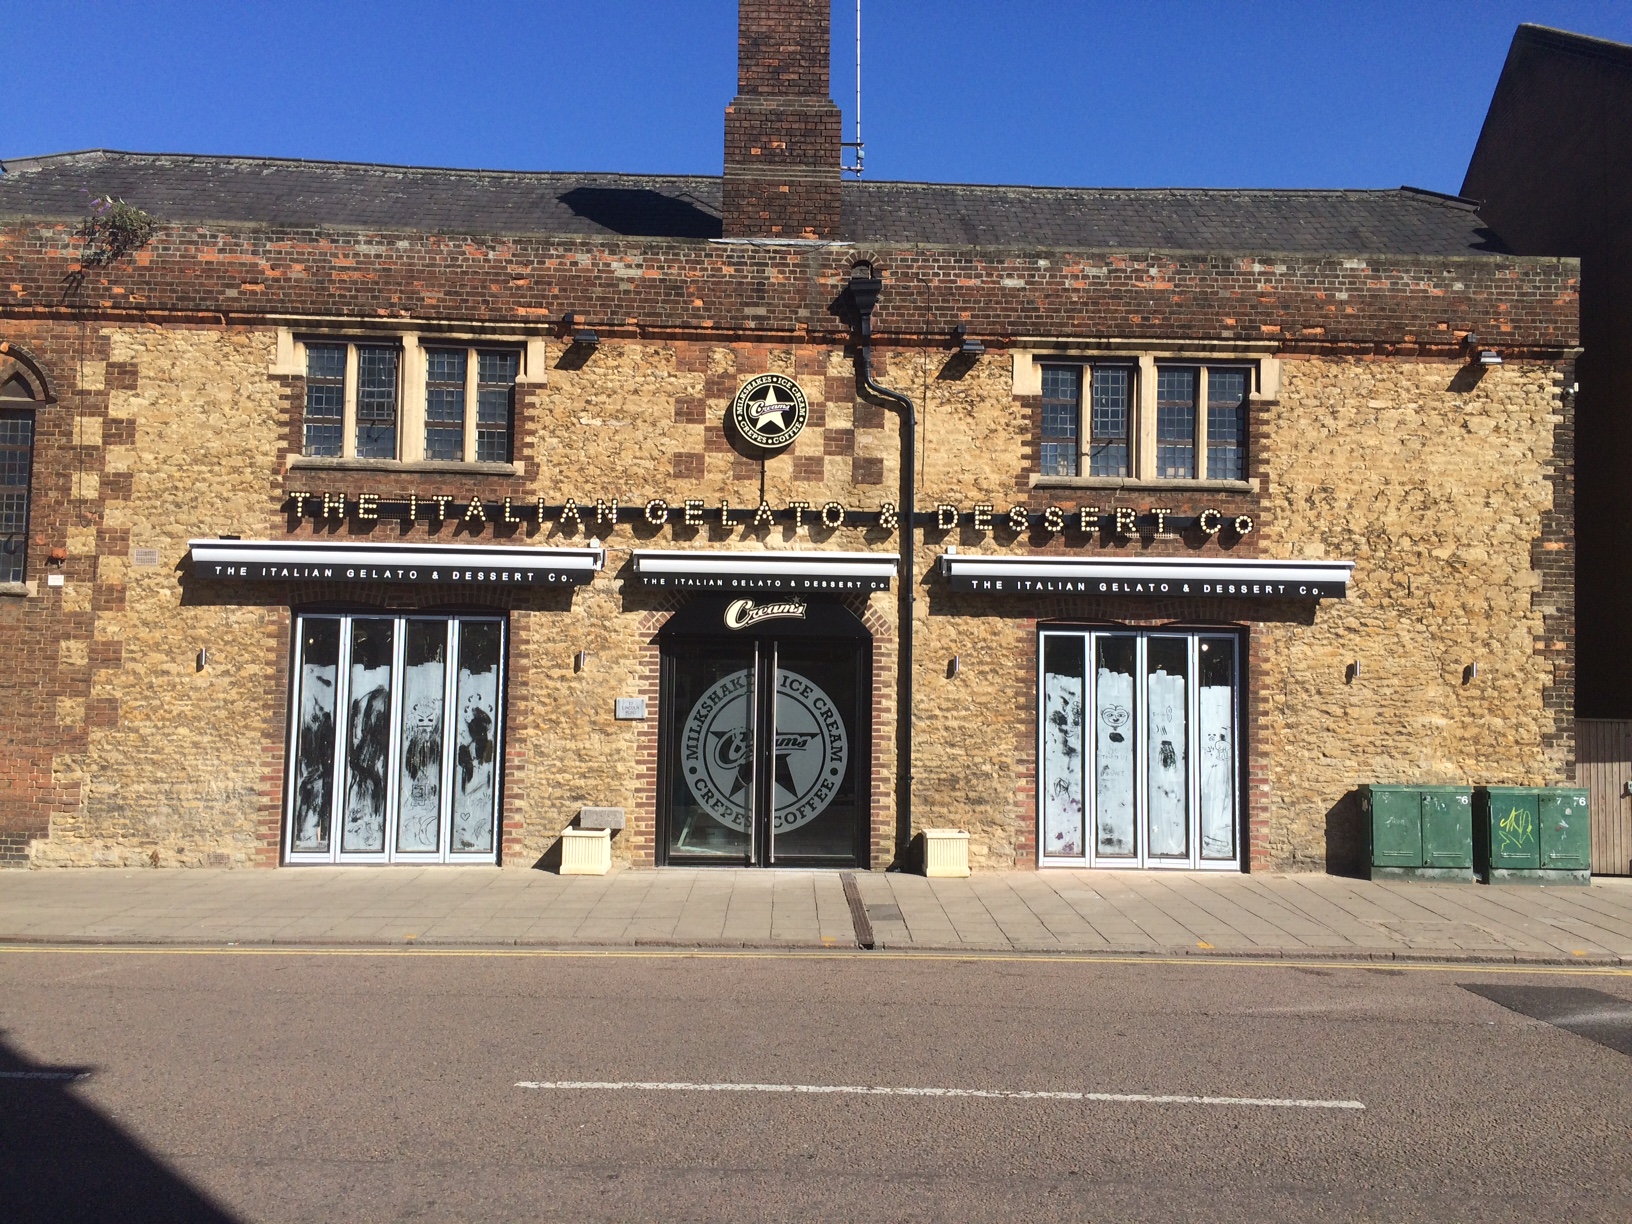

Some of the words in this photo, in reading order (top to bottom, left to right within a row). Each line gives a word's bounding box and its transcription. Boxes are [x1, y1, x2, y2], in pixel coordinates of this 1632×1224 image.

[737, 376, 772, 415] MILKSHAKES
[777, 377, 792, 389] ICE
[791, 387, 806, 416] CREAM
[740, 421, 767, 443] CREPES
[773, 421, 802, 444] COFFEE
[289, 491, 379, 519] THE
[409, 494, 618, 524] ITALIAN
[645, 498, 845, 527] GELATO
[879, 502, 900, 529] &
[937, 504, 1172, 533] DESSERT
[1199, 507, 1254, 535] Co
[215, 566, 248, 576] THE
[262, 567, 333, 577] ITALIAN
[347, 569, 418, 579] GELATO
[431, 571, 439, 580] &
[452, 571, 534, 581] DESSERT
[548, 572, 573, 582] Co.
[643, 577, 666, 585] THE
[675, 578, 723, 587] ITALIAN
[732, 579, 782, 588] GELATO
[804, 580, 862, 589] DESSERT
[972, 580, 1003, 590] THE
[1017, 581, 1085, 591] ITALIAN
[1099, 583, 1169, 592] GELATO
[1183, 584, 1190, 593] &
[1203, 584, 1285, 594] DESSERT
[1299, 586, 1325, 595] Co.
[686, 673, 756, 762] MILKSHAKE
[780, 674, 814, 699] ICE
[812, 697, 843, 763] CREAM
